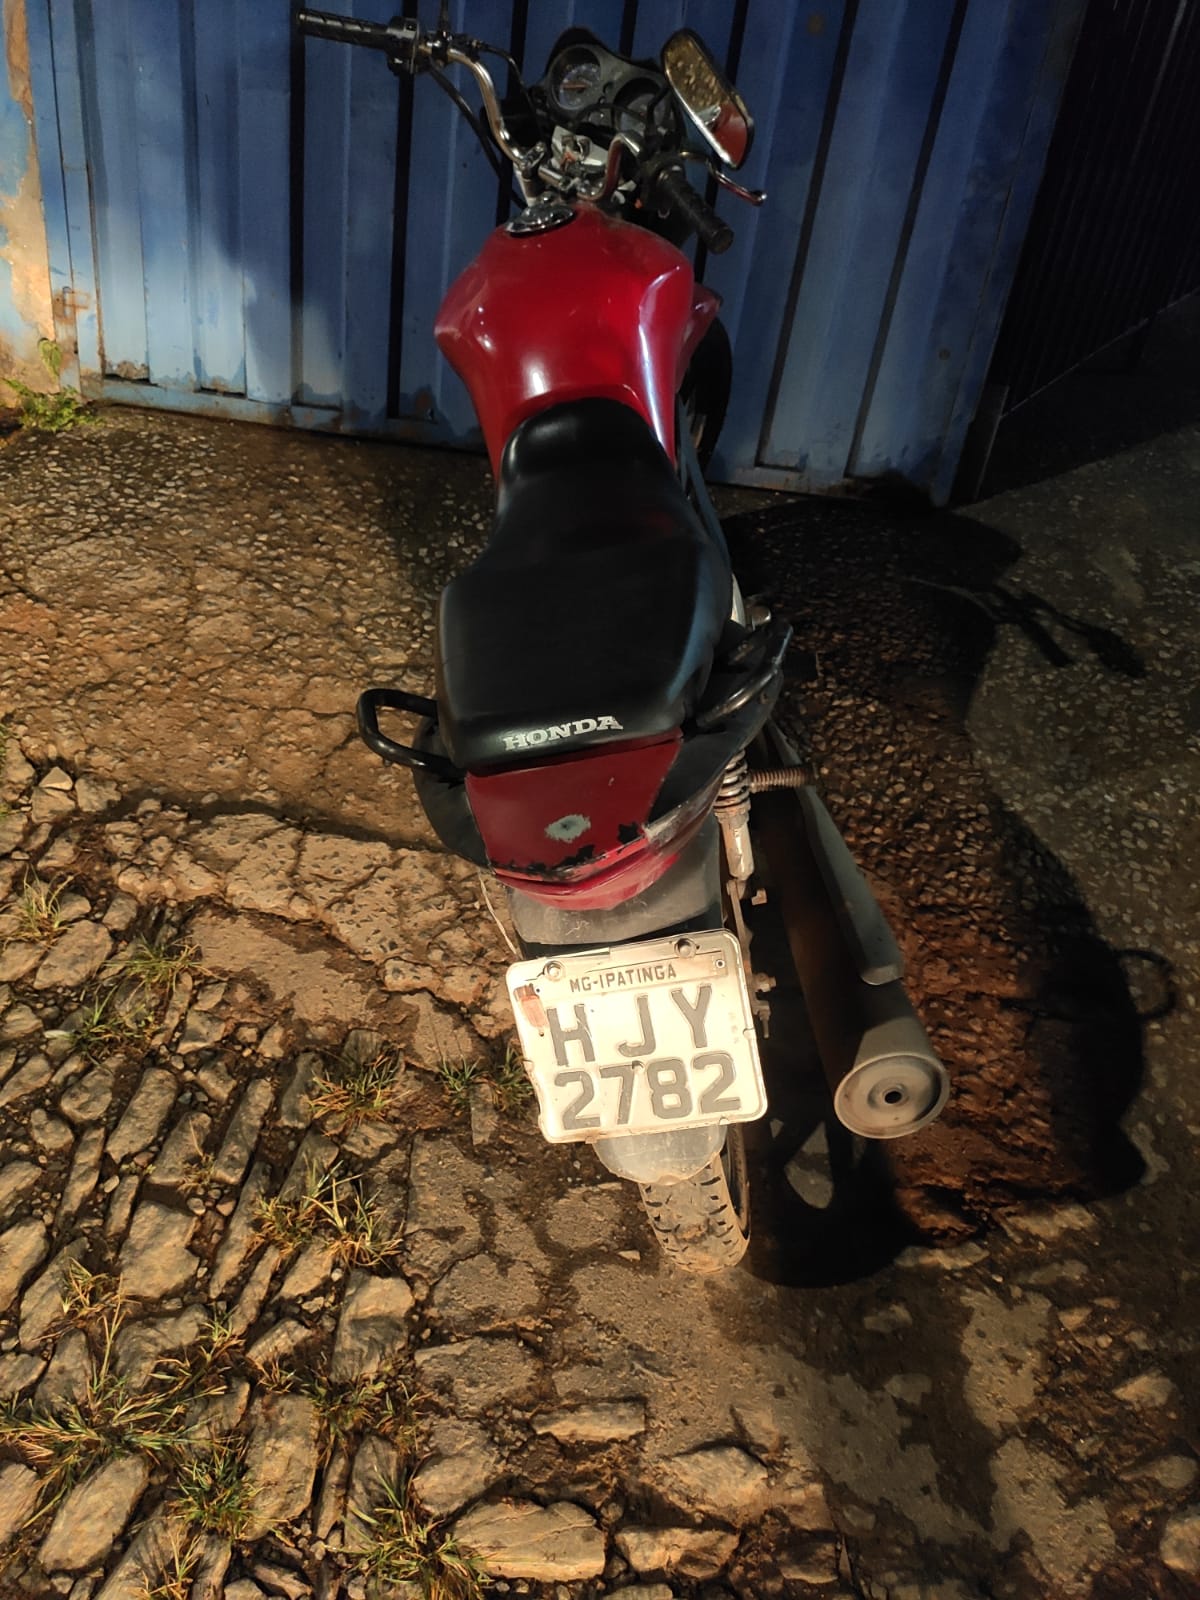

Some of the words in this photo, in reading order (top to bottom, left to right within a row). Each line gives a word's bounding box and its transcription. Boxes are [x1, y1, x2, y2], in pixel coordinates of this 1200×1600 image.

[503, 715, 623, 750] HONDA
[569, 963, 677, 993] MG-IPATINGA
[546, 984, 712, 1066] HJY
[554, 1052, 741, 1130] 2782
